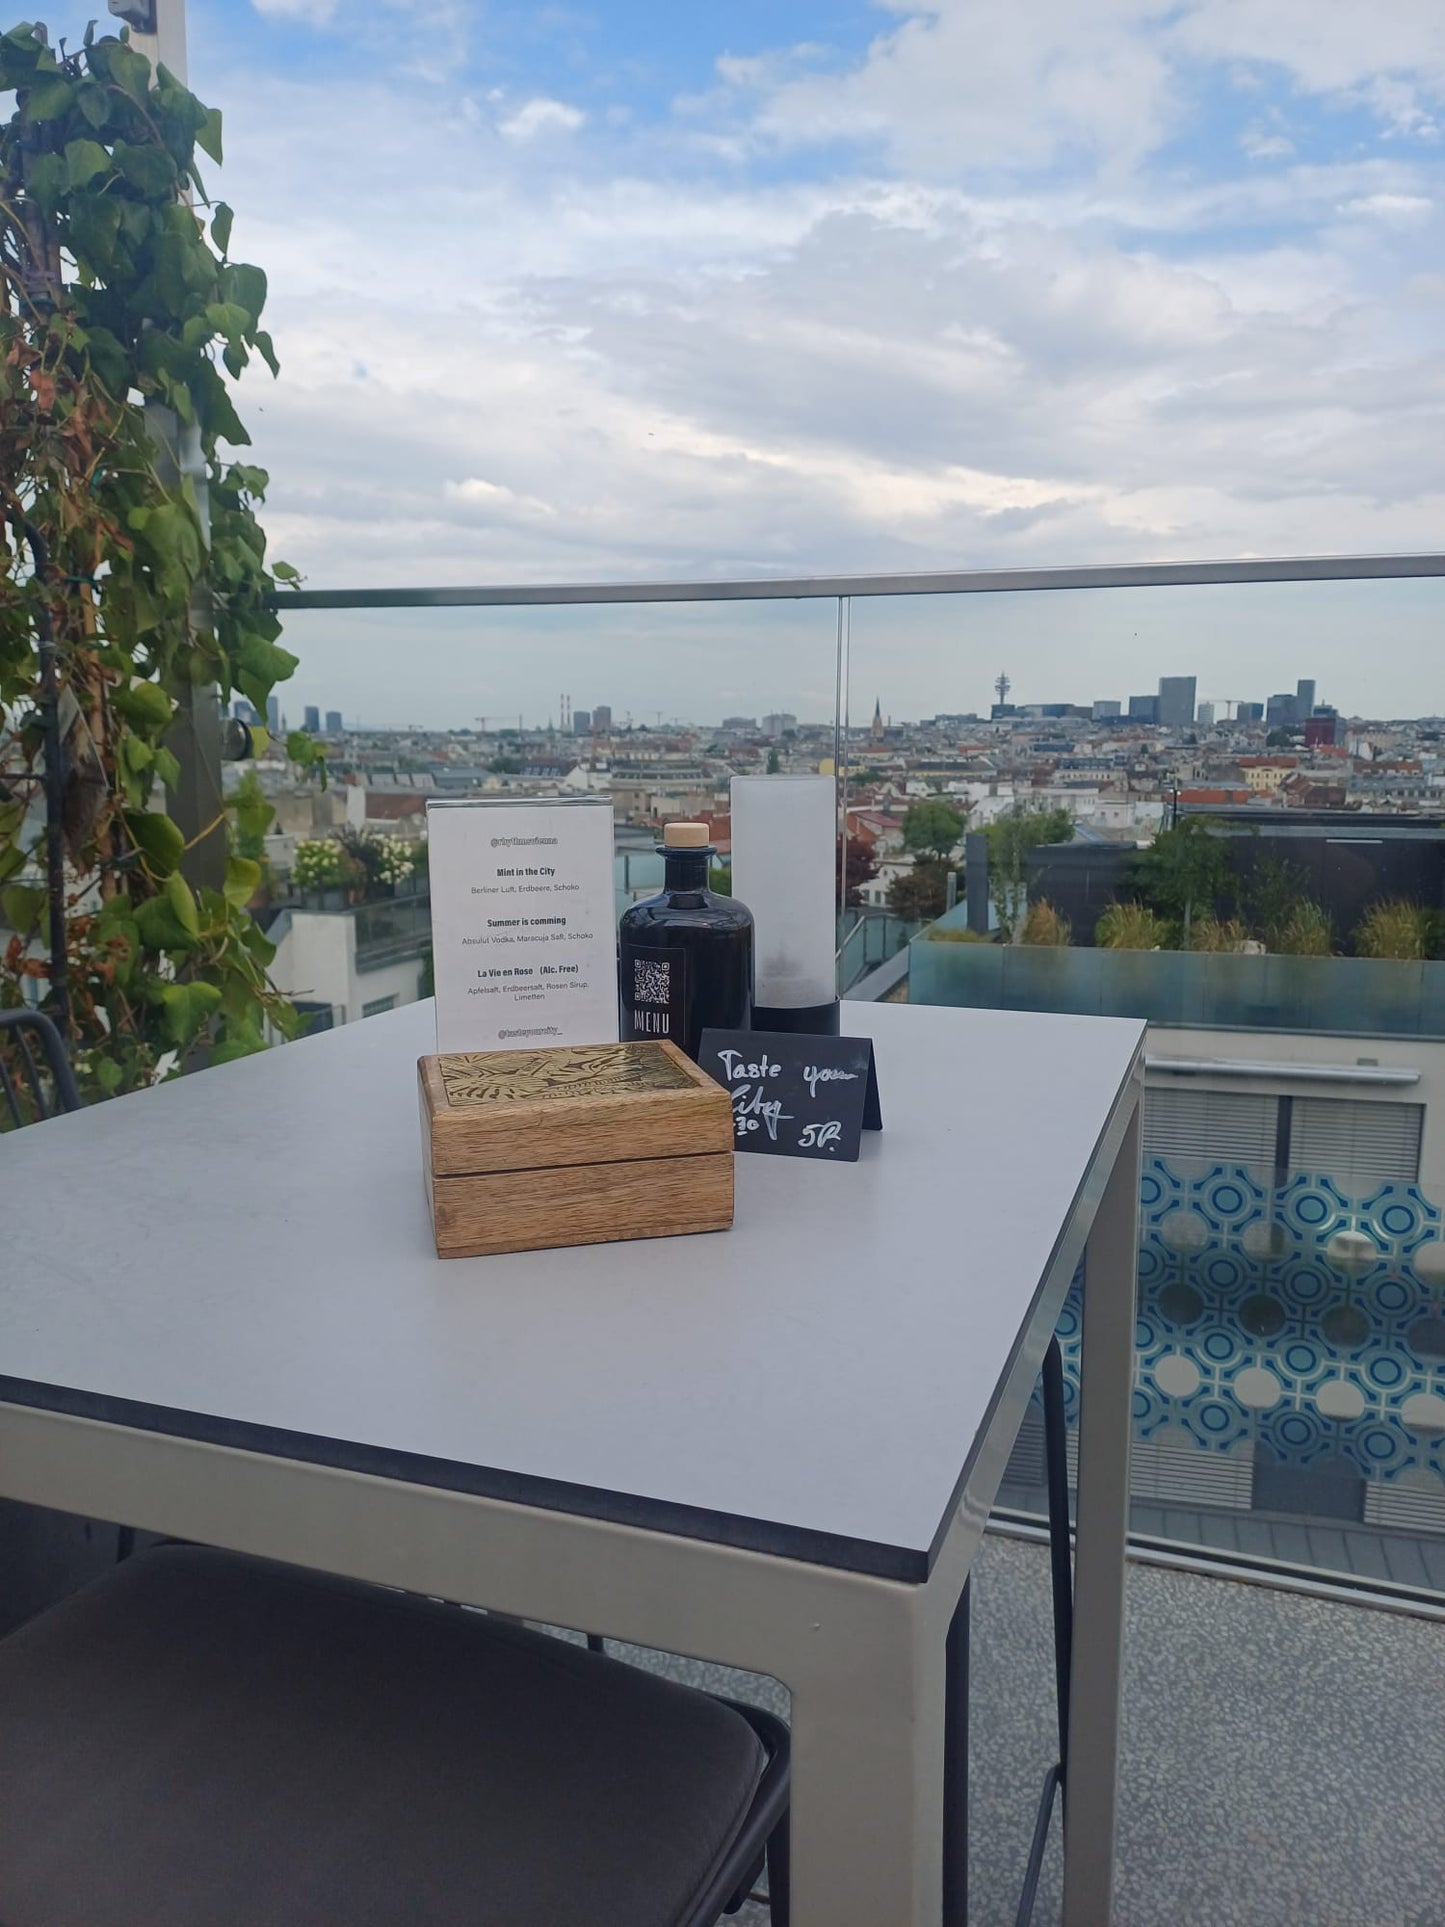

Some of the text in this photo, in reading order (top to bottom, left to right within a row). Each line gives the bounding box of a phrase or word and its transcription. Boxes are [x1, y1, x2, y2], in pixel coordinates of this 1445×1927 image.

[496, 866, 556, 877] Mint in the City
[471, 886, 499, 894] Berliner
[518, 884, 552, 893] Erdbeere,
[553, 882, 580, 891] Schoko
[487, 916, 567, 927] Summer is comming
[491, 936, 515, 944] Vodka,
[516, 934, 549, 943] Maracuja
[567, 931, 594, 940] Schoko
[477, 963, 579, 978] La Vie en Rose (Alc. Free)
[546, 982, 568, 991] Rosen
[514, 993, 545, 1002] Limetten
[633, 1008, 670, 1034] MENU
[717, 1049, 782, 1081] Taste
